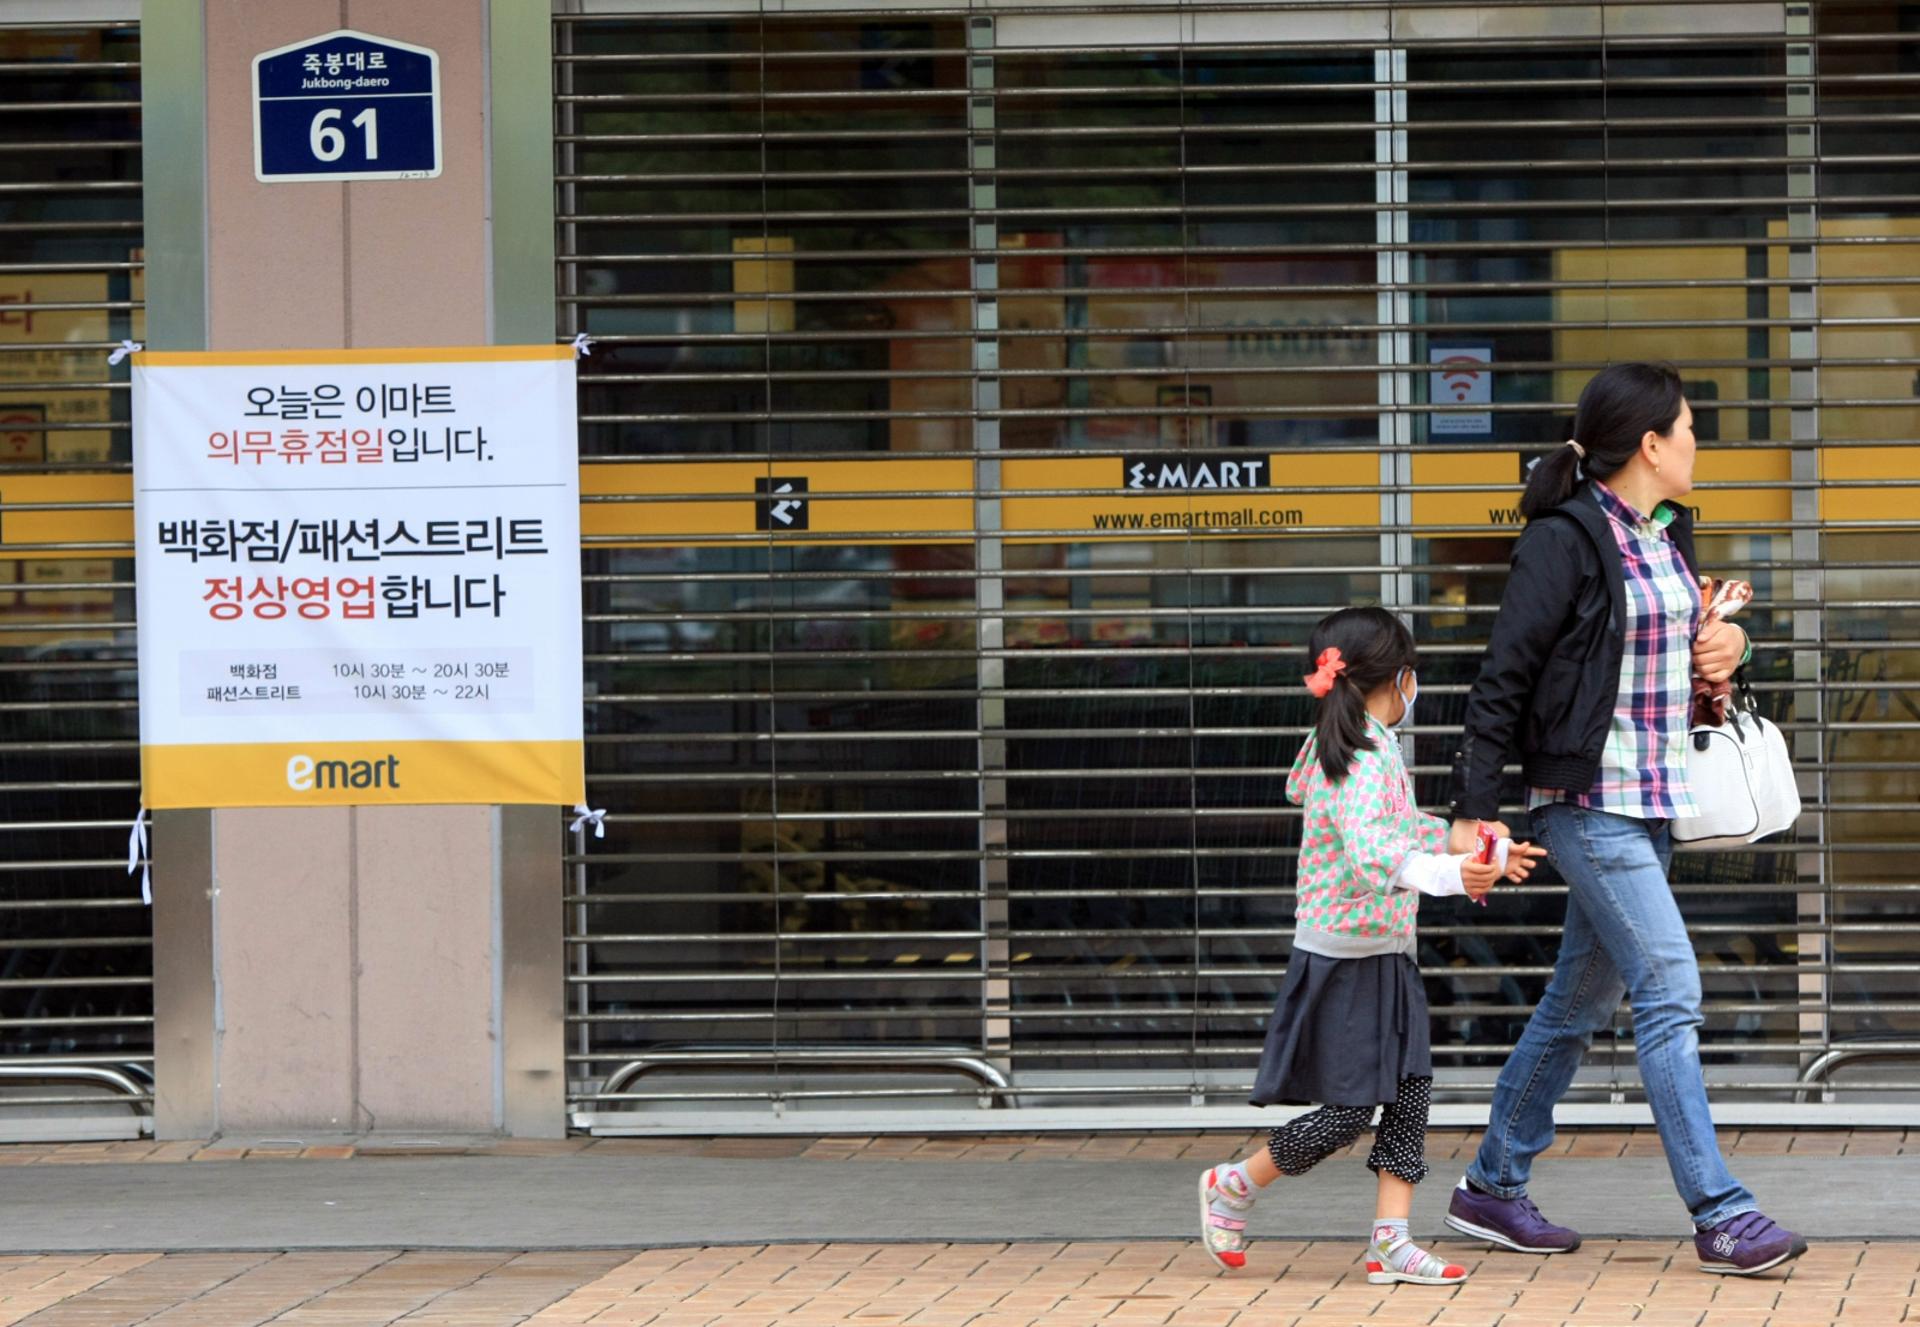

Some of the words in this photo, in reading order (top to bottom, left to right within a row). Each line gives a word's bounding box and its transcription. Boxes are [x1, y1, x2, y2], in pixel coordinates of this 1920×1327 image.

[302, 52, 388, 75] 죽봉대로
[301, 76, 390, 90] Jukbong-daero
[310, 107, 378, 162] 61
[244, 384, 345, 420] 오늘은
[356, 383, 456, 418] 이마트
[207, 426, 494, 464] 의무휴점일입니다.
[1093, 508, 1303, 529] www.emartmall.com
[158, 516, 549, 563] 백화점/패션스트리트
[202, 573, 507, 620] 정상영업합니다
[229, 663, 278, 680] 백화점
[333, 663, 365, 678] 10시
[371, 663, 405, 679] 30분
[434, 663, 468, 679] 20시
[475, 662, 509, 678] 30분
[207, 685, 302, 702] 패션스트리트
[354, 685, 386, 700] 10시
[392, 684, 426, 700] 30분
[455, 684, 489, 700] 22시
[287, 754, 400, 791] emart
[1713, 1232, 1739, 1257] 55
